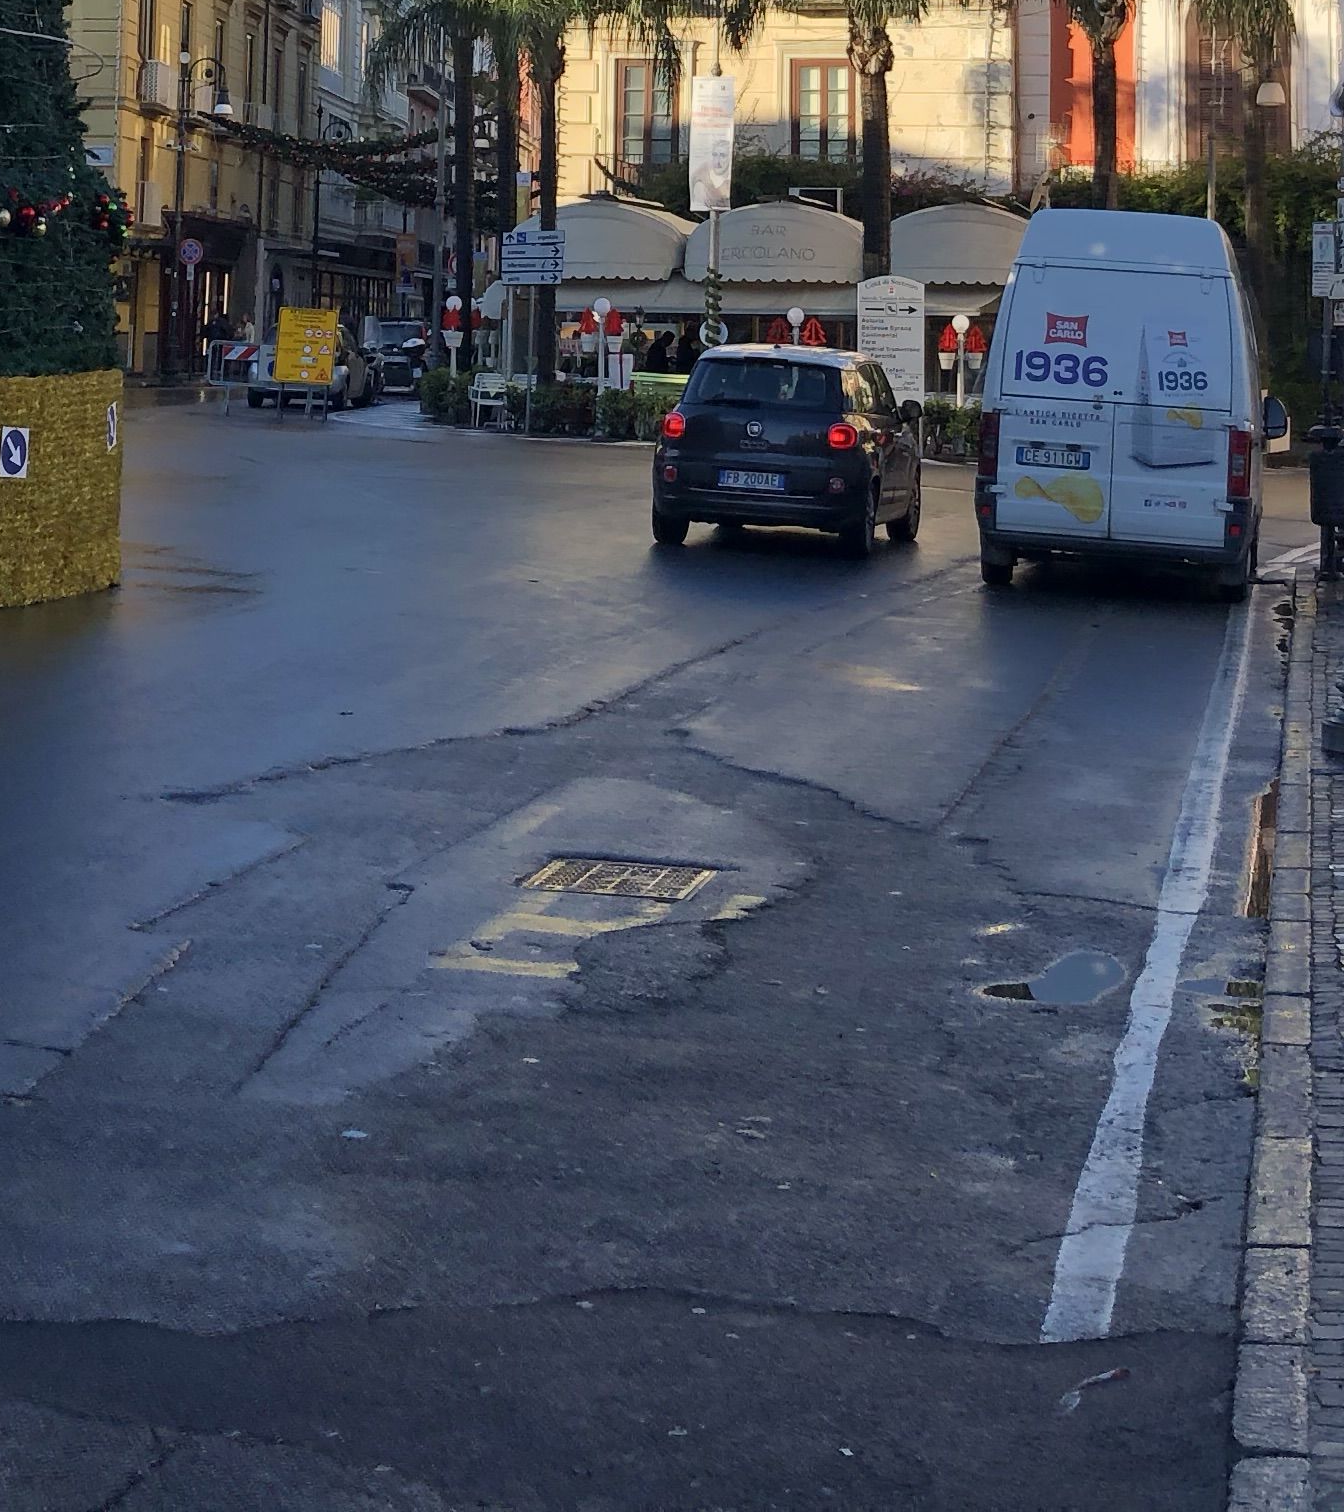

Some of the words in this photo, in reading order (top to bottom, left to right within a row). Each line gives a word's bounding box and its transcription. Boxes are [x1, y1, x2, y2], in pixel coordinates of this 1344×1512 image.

[751, 224, 787, 237] BAR
[720, 246, 816, 261] ERCOLANO
[1056, 320, 1078, 330] SAN
[1049, 329, 1084, 340] CARLO
[1014, 349, 1108, 388] 1936
[1158, 370, 1209, 392] 1936
